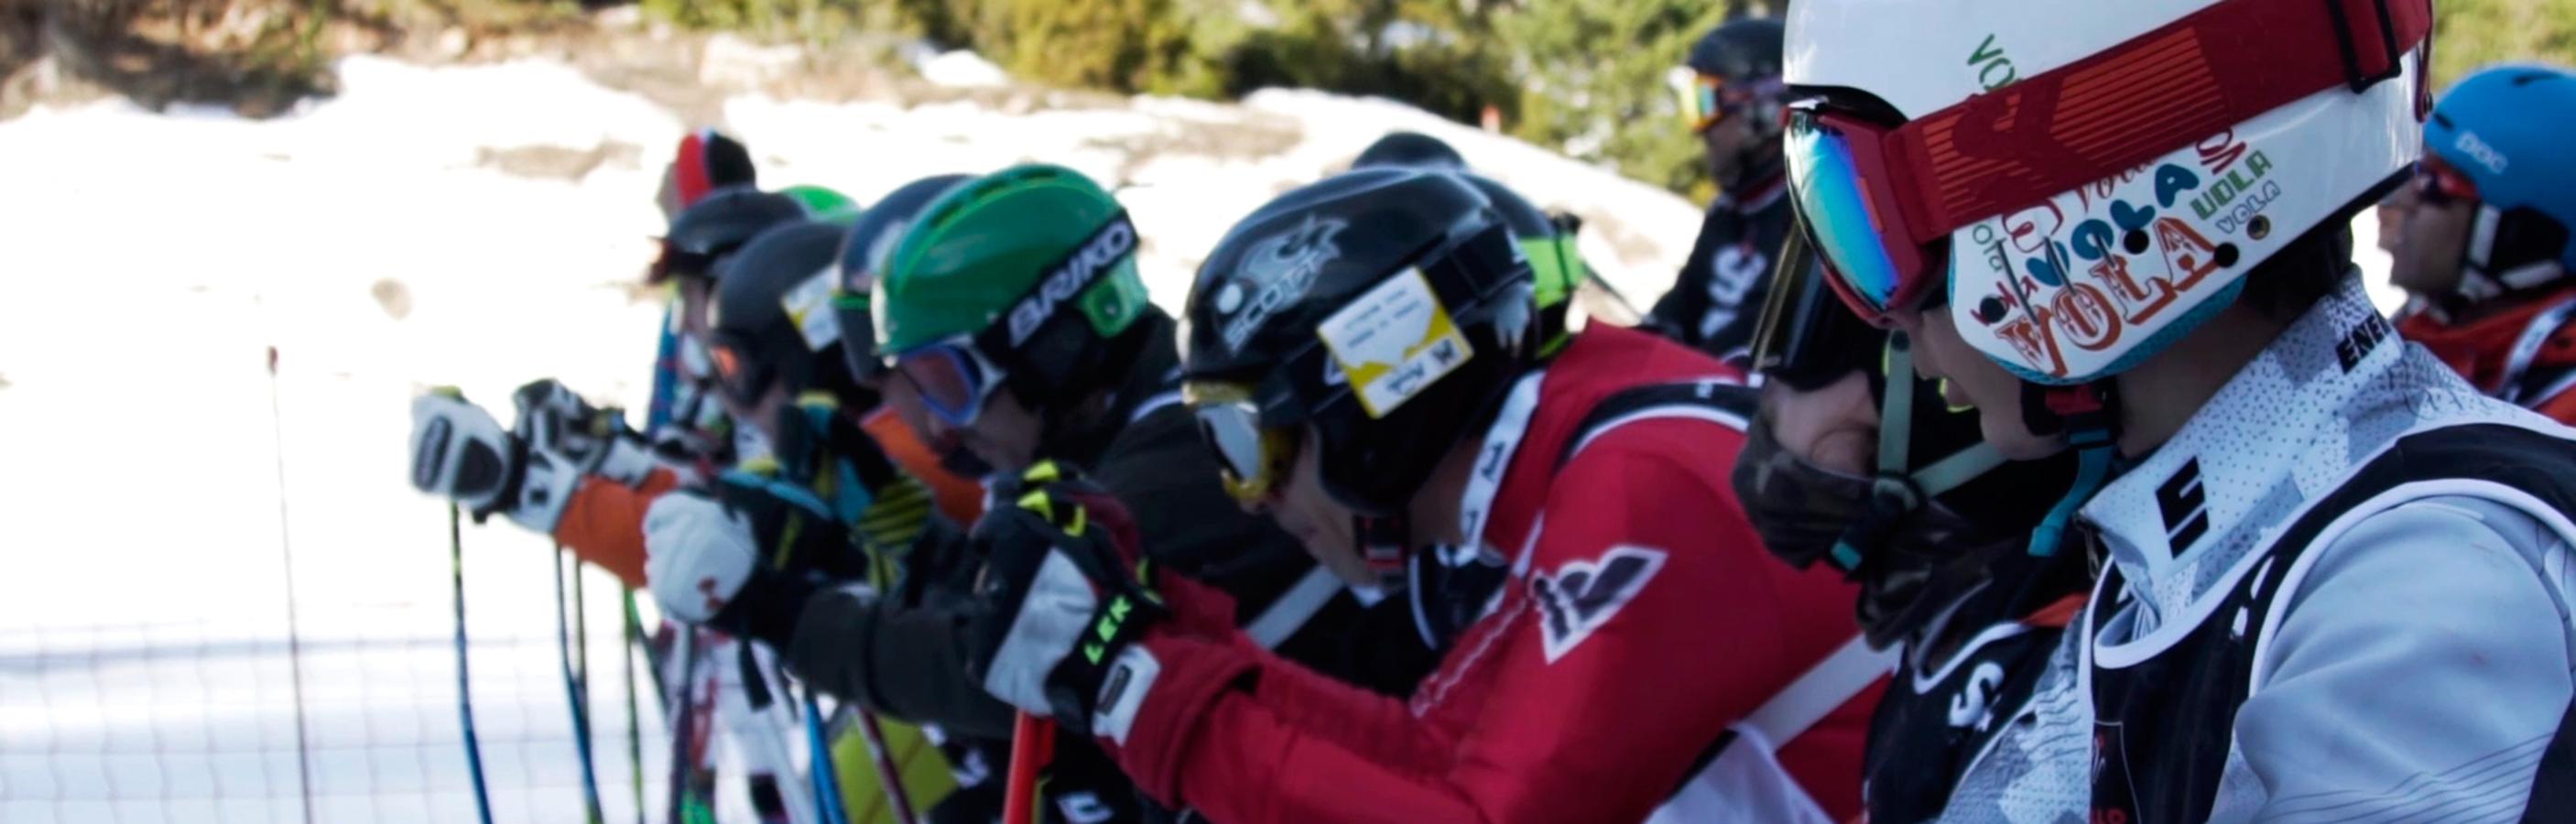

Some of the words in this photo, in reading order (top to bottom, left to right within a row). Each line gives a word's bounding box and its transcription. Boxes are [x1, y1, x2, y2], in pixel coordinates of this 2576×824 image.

[2026, 163, 2200, 287] VOLA
[2215, 179, 2281, 234] VOLA
[1008, 221, 1133, 348] BRIKO
[1223, 249, 1320, 356] SCOTT
[1994, 216, 2221, 377] VOLA
